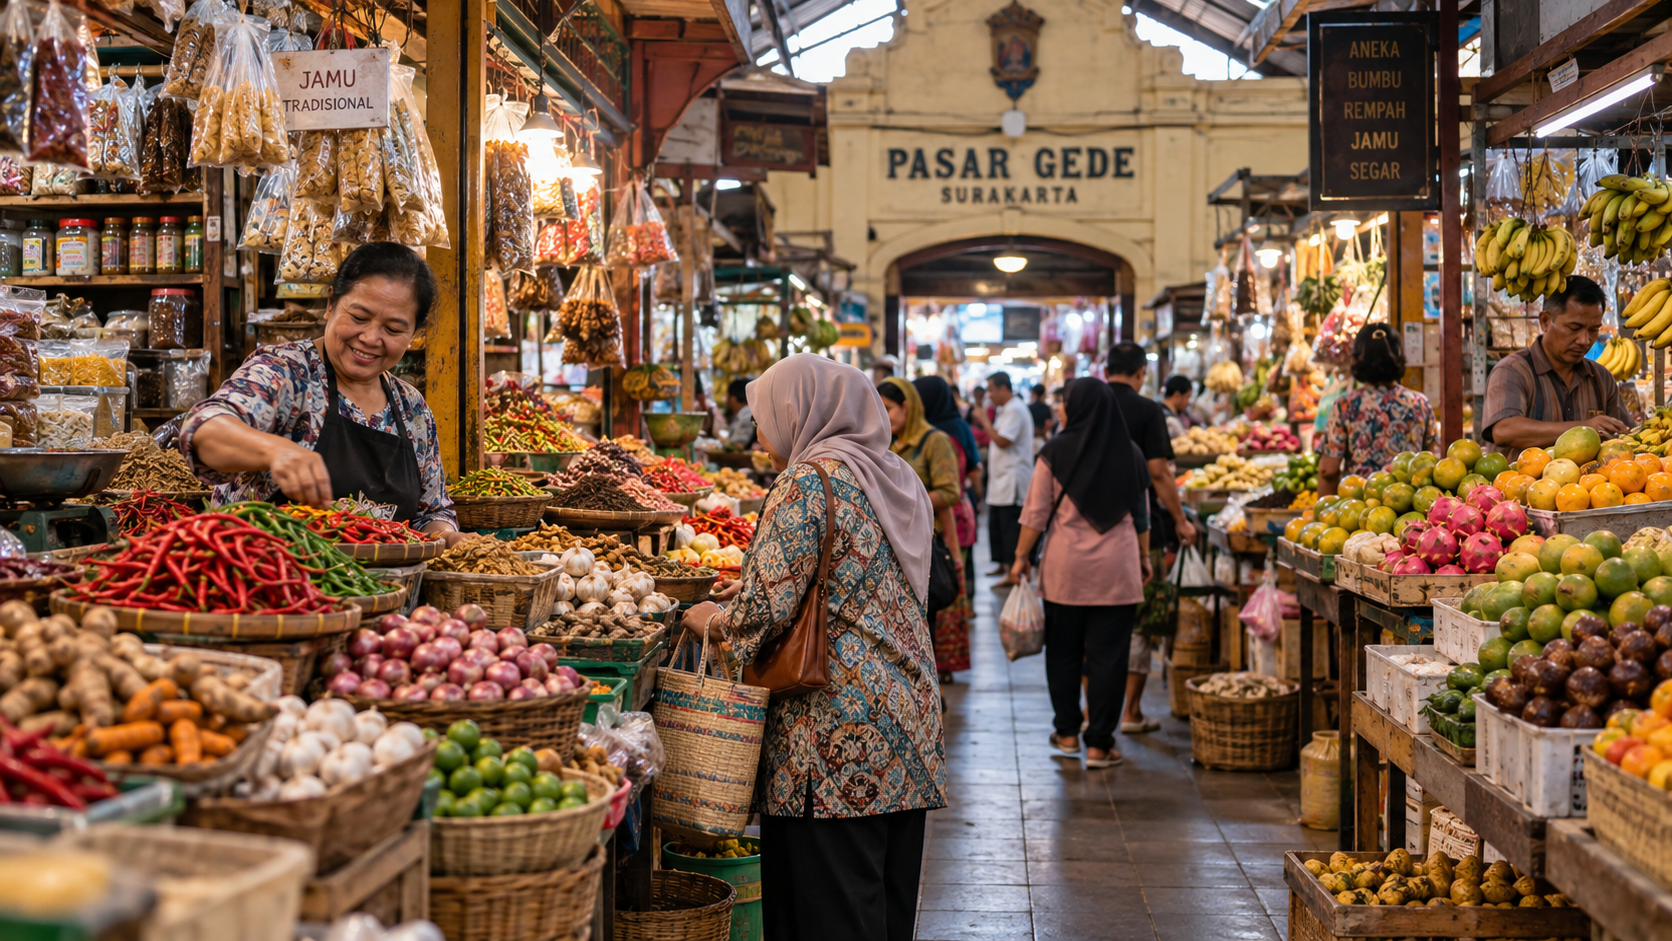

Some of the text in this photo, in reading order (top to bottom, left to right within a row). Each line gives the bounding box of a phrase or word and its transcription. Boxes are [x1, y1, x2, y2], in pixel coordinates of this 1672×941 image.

[1349, 40, 1401, 59] ANEKA
[299, 69, 356, 90] JAMU
[1348, 71, 1402, 89] BUMBU
[282, 96, 374, 113] TRADISIONAL
[1344, 101, 1406, 120] REMPAH
[1350, 131, 1399, 150] JAMU
[887, 147, 1135, 179] PASAR GEDE
[1349, 162, 1401, 180] SEGAR
[940, 186, 1078, 204] SURAKARTA
